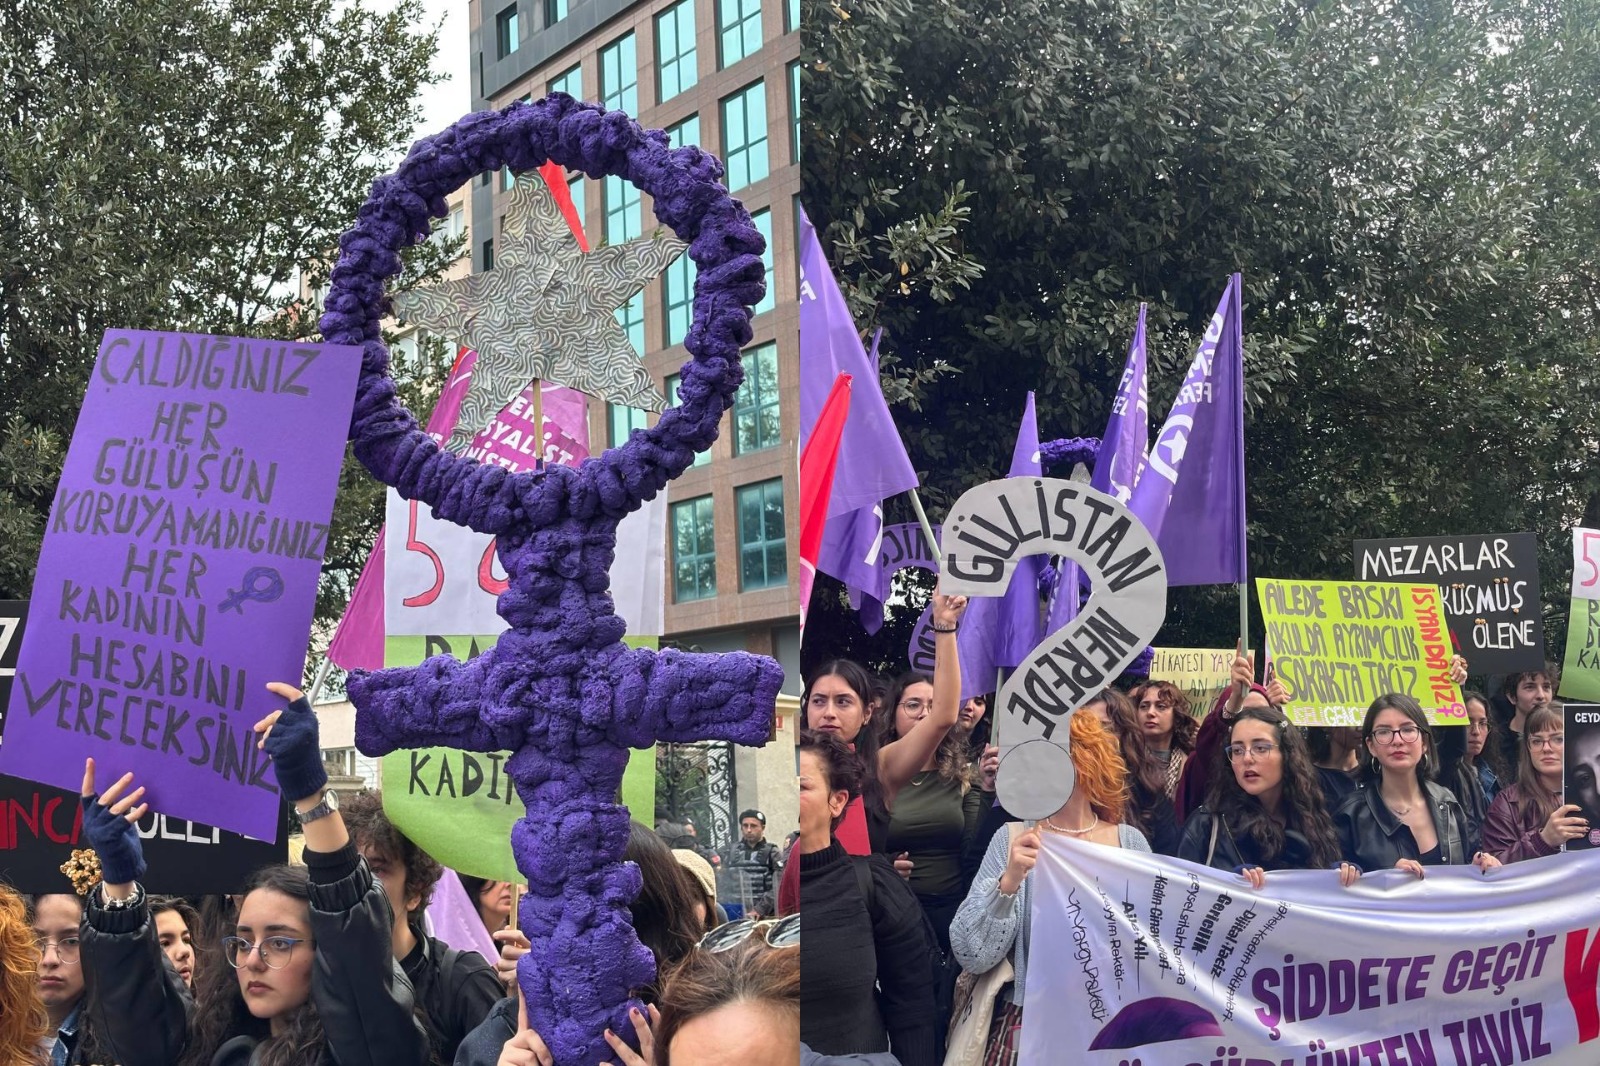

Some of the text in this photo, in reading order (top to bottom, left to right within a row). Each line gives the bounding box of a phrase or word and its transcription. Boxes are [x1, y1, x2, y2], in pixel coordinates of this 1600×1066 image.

[100, 336, 321, 396] ÇALDIĞINIZ
[150, 401, 228, 450] HER
[93, 437, 278, 505] GÜLÜŞÜN
[52, 488, 330, 561] KORUYAMADIĞINIZ
[947, 479, 1162, 593] GÜLİSTAN
[121, 543, 208, 599] HER
[1362, 539, 1516, 580] MEZARLAR
[59, 579, 206, 646] KADININ
[1264, 580, 1404, 620] AİLEDE BASKI
[1440, 576, 1528, 615] KÜSMÜŞ
[1211, 652, 1234, 673] YAR
[1268, 620, 1328, 657] OKULDA
[1332, 623, 1420, 661] AYRIMCILIK
[1472, 617, 1536, 650] ÖLENE
[70, 633, 246, 711] HESABINI
[1007, 606, 1140, 741] NEREDE
[1276, 656, 1365, 704] SOKAKTA
[1191, 892, 1234, 955] Gericilik
[1210, 909, 1257, 978] Dijital Taciz
[1110, 939, 1126, 982] Rektör
[1251, 953, 1436, 1041] ŞİDDETE
[1442, 928, 1557, 996] GEÇİT
[1442, 997, 1552, 1066] TAVİZ
